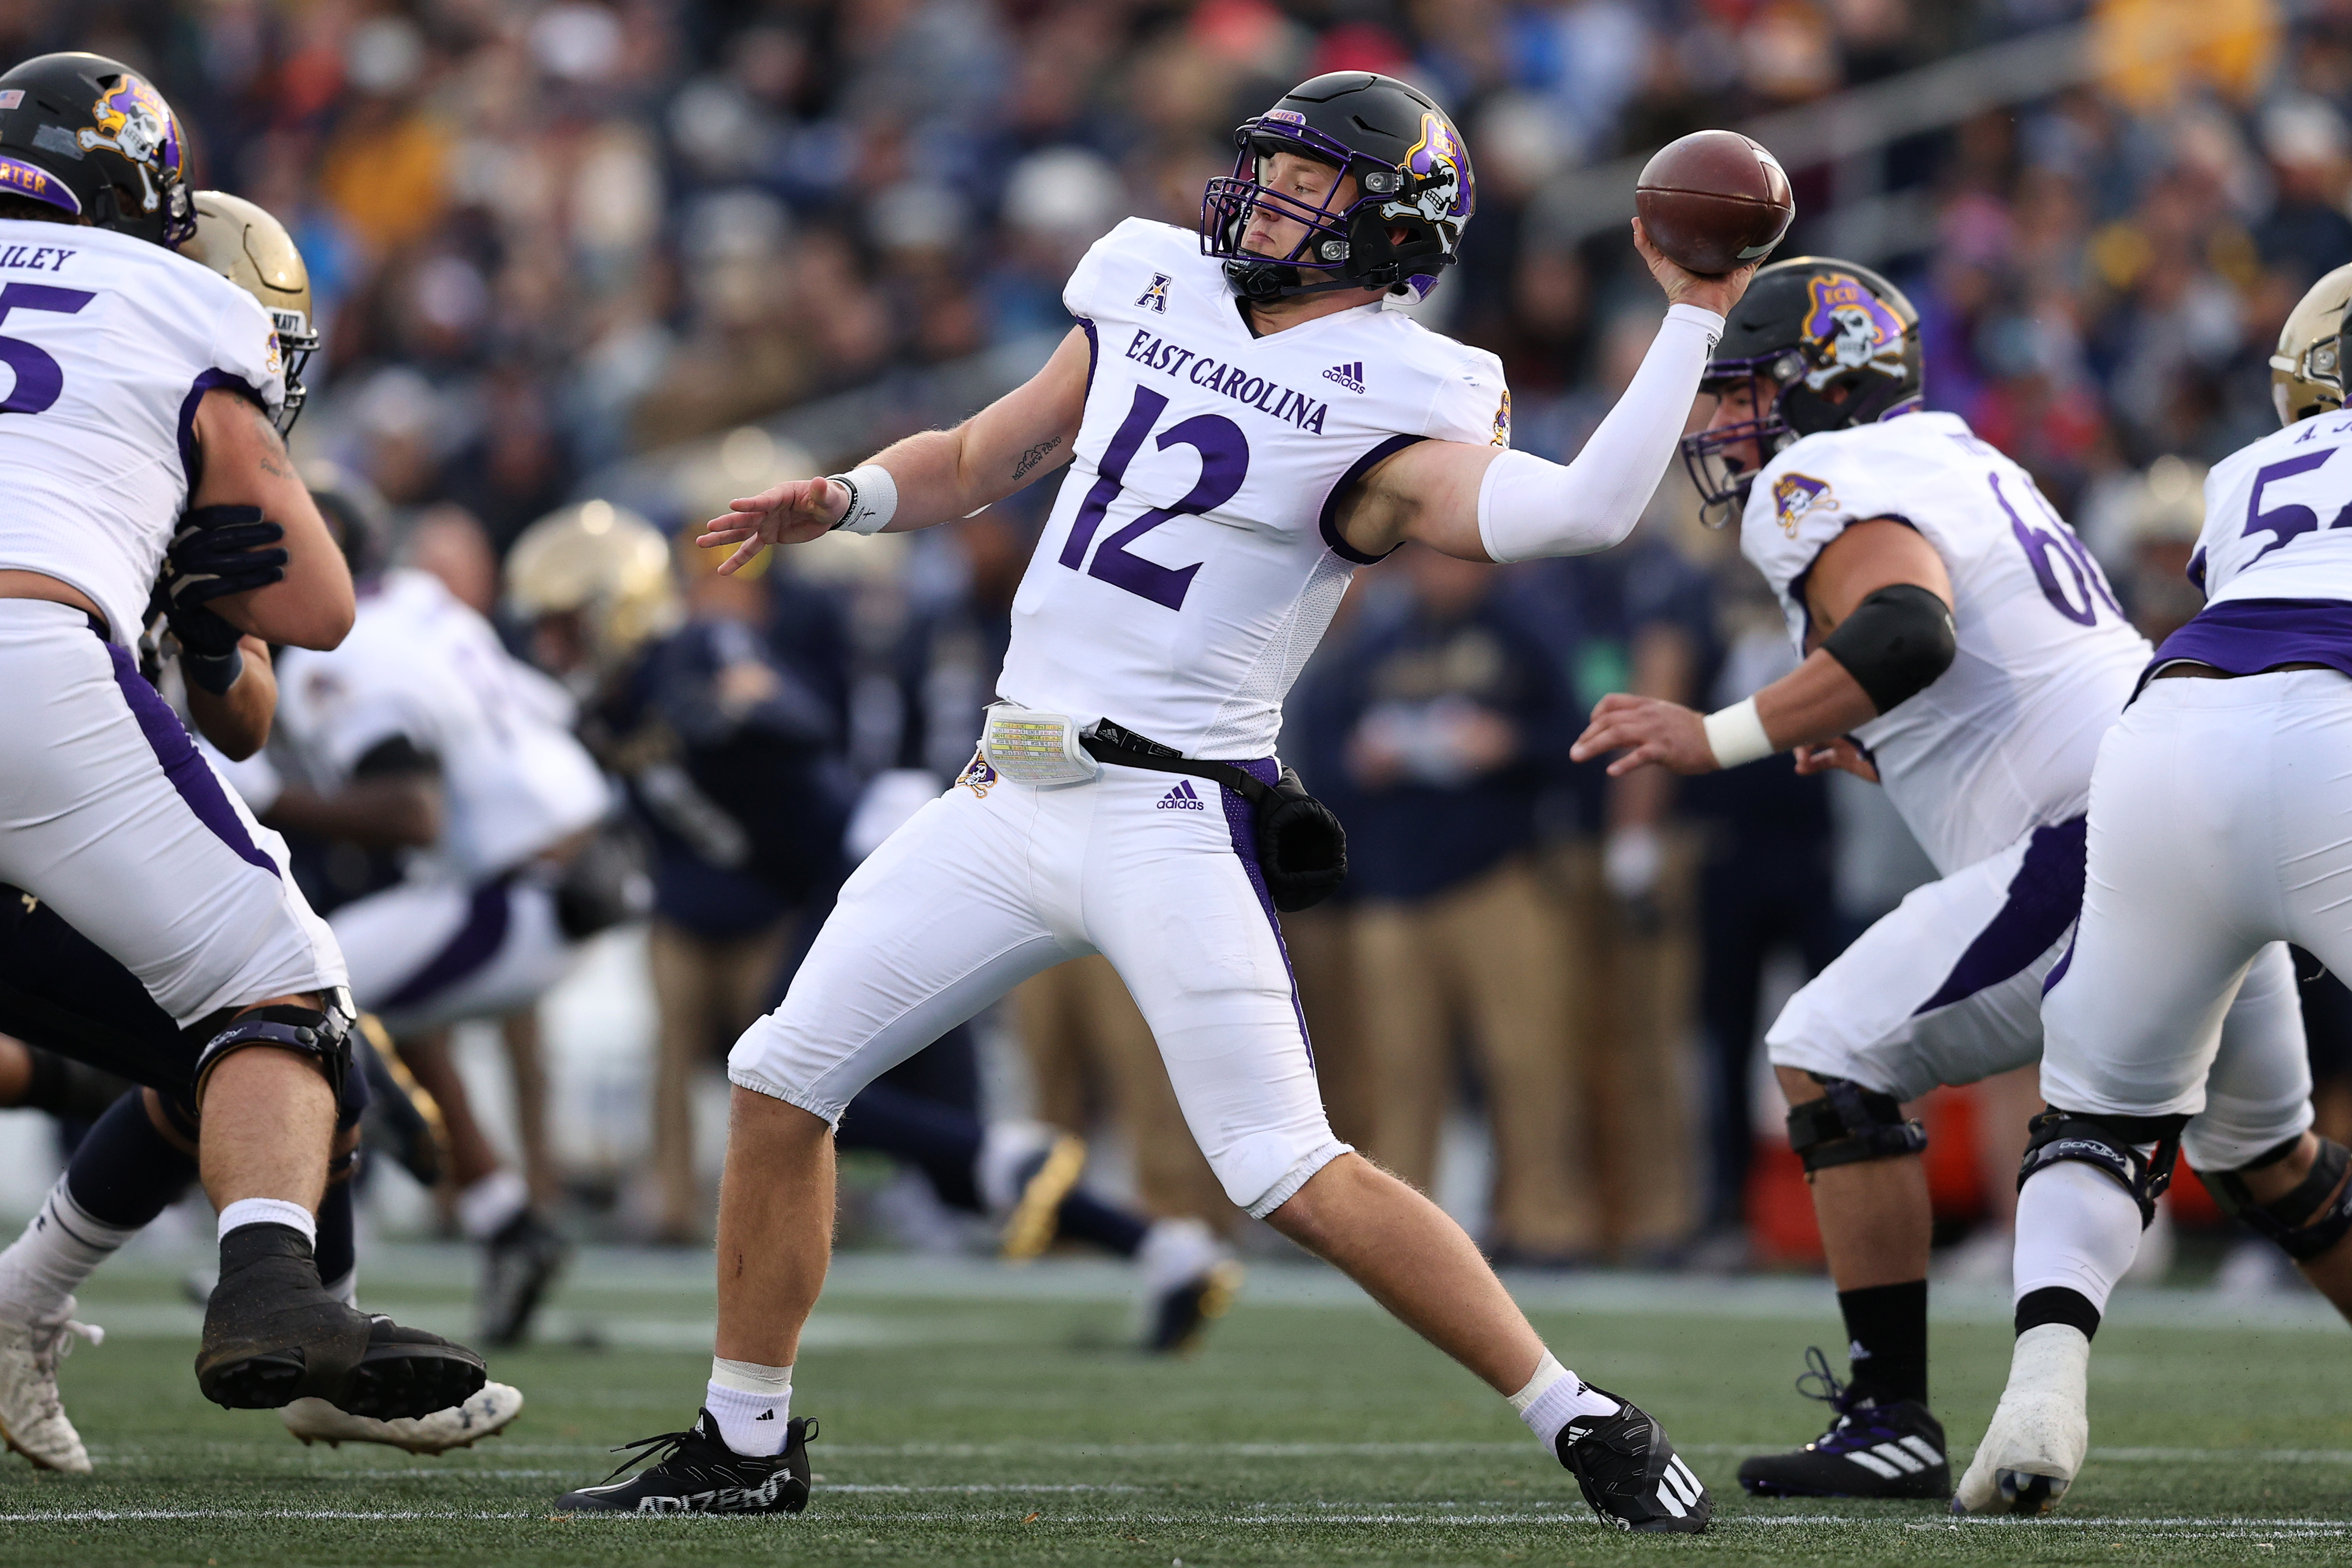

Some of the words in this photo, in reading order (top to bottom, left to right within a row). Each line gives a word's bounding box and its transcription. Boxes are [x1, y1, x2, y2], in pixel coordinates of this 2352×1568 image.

[1432, 131, 1456, 157] ECU
[0, 245, 77, 271] ILEY
[1824, 287, 1858, 304] ECU
[273, 313, 300, 331] NAVY
[0, 282, 97, 414] 5
[1125, 329, 1195, 377] EAST
[1190, 358, 1328, 435] CAROLINA
[1323, 370, 1366, 394] adidas
[1058, 384, 1249, 612] 12
[2240, 447, 2352, 574] 5
[1099, 730, 1119, 744] adidas
[1157, 798, 1204, 810] adidas
[2059, 1142, 2125, 1162] DONJOY
